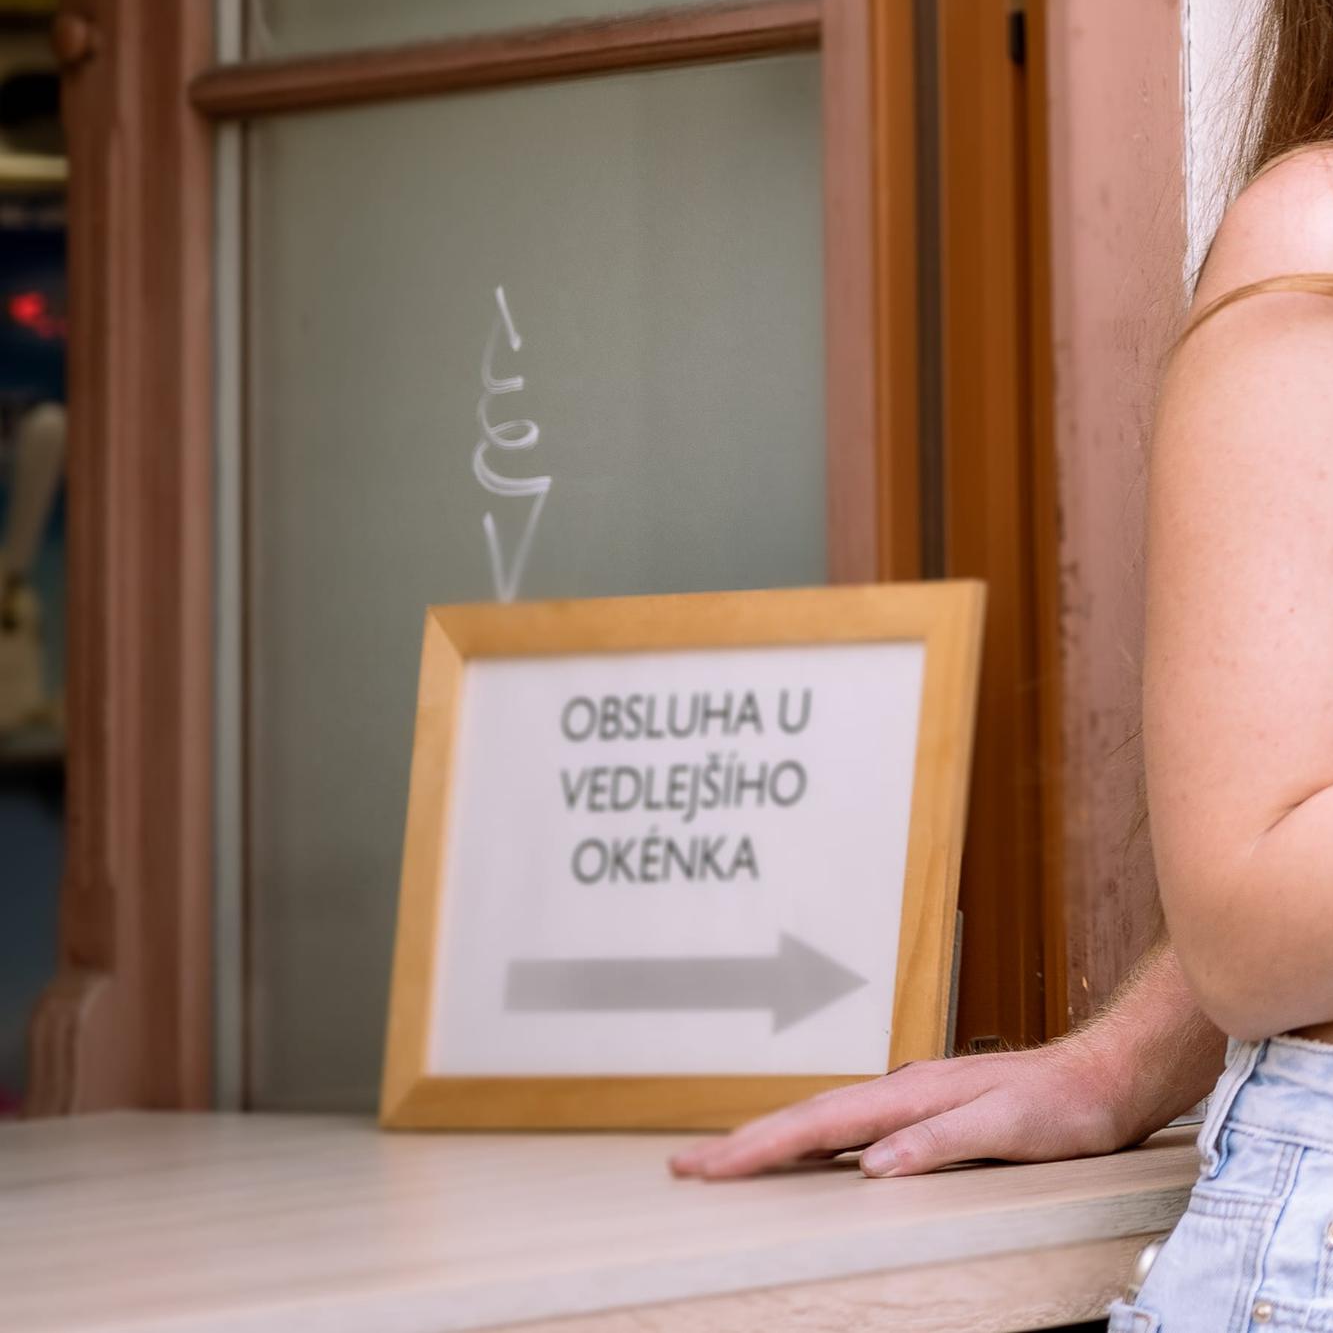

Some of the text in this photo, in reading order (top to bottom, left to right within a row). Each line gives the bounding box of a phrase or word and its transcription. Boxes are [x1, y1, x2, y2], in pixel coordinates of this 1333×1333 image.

[560, 687, 812, 743] OBSLUHA U
[559, 750, 808, 824] VEDLEJŠÍHO
[570, 823, 760, 886] OKÉNKA
